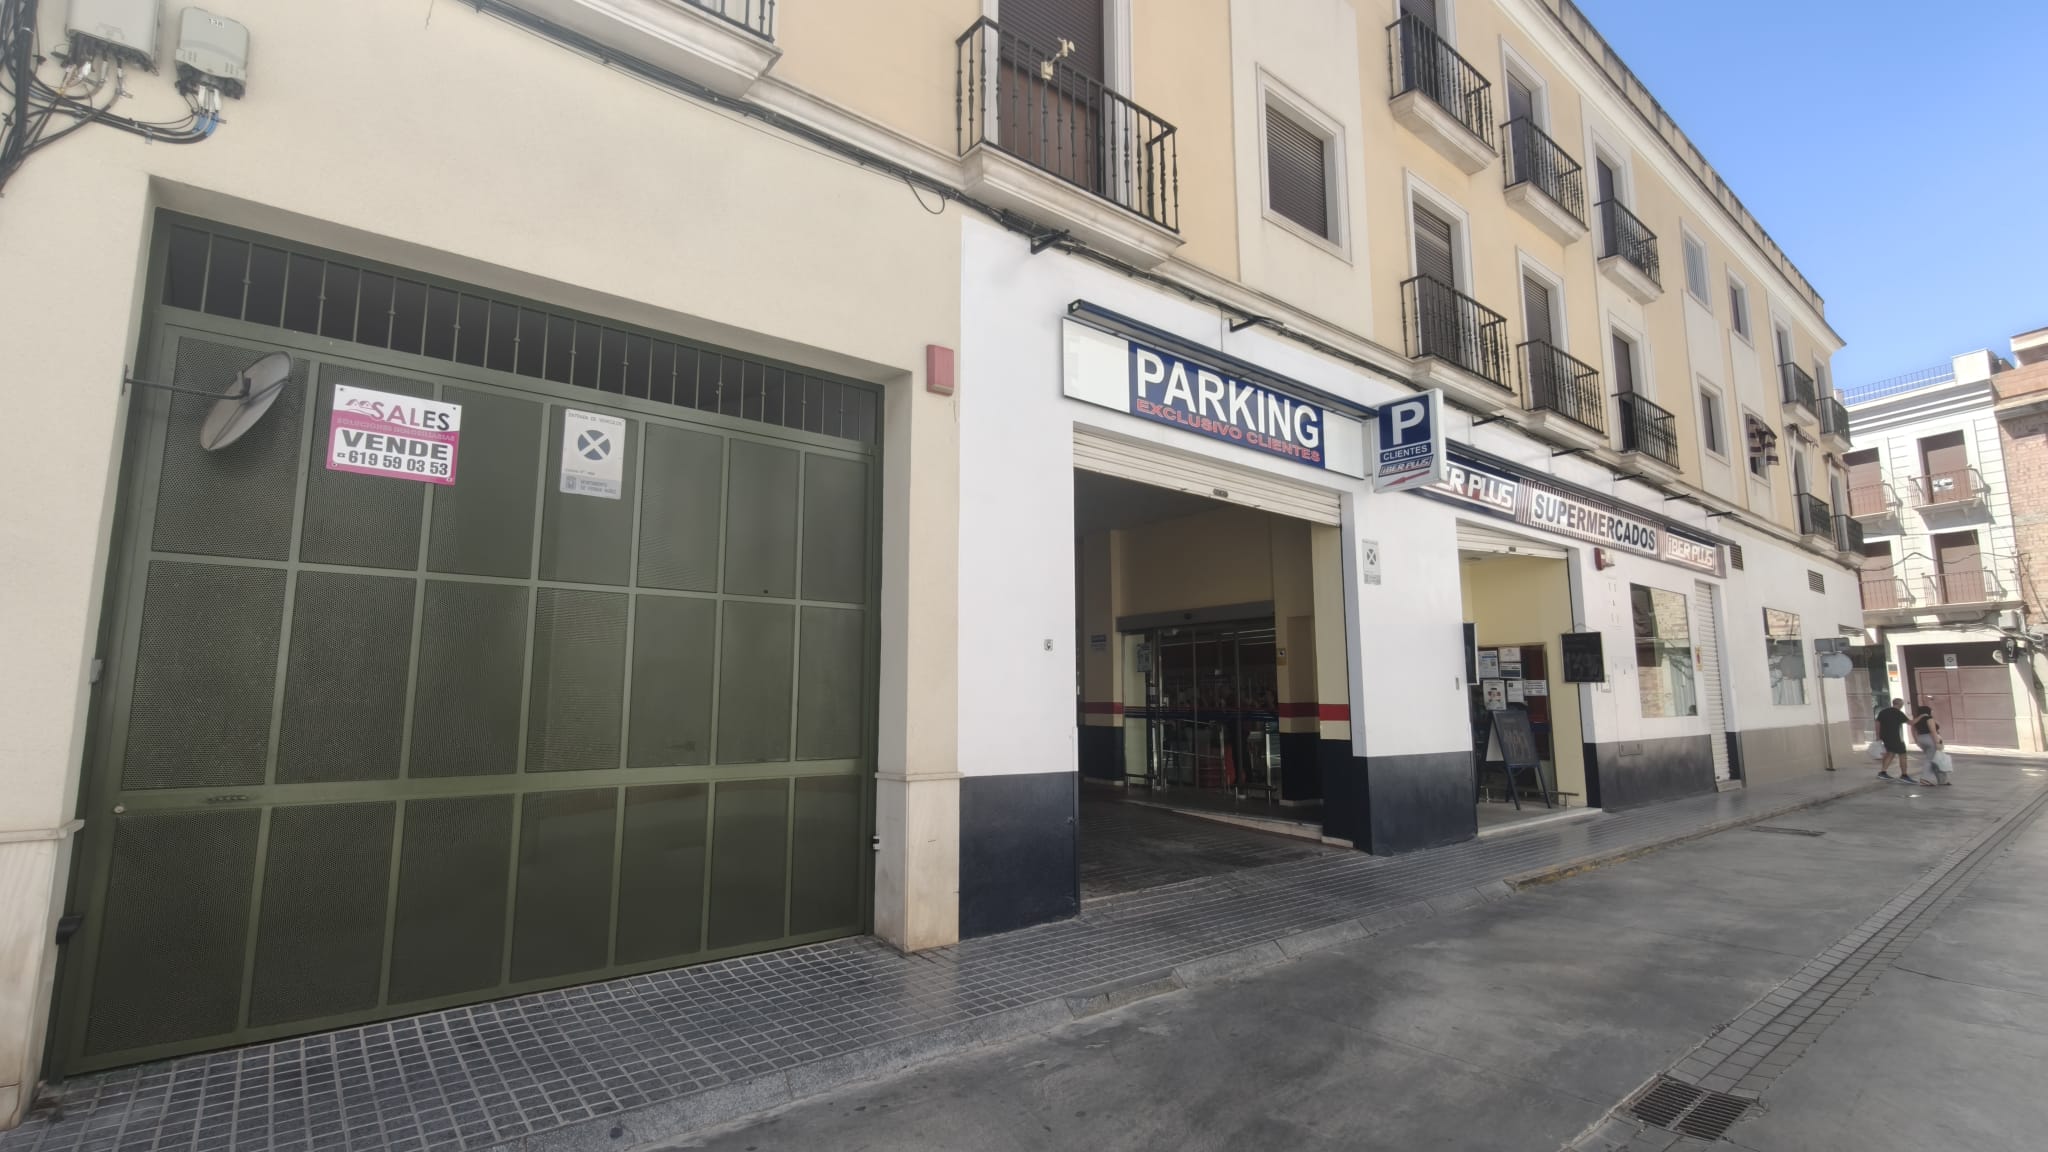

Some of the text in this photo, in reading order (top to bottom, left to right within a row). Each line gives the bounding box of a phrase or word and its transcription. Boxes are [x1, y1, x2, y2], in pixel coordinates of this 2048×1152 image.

[1136, 348, 1319, 448] PARKING
[371, 401, 450, 431] SALES
[1136, 399, 1321, 463] EXCLUSIVO CLIENTES
[1391, 401, 1425, 446] P
[341, 429, 448, 461] VENDE
[1383, 444, 1428, 461] CLIENTES
[348, 450, 449, 476] 619 59 03 53
[1468, 473, 1513, 508] PLUS
[1534, 494, 1656, 550] SUPERMERCADOS
[1692, 545, 1713, 566] PLUS
